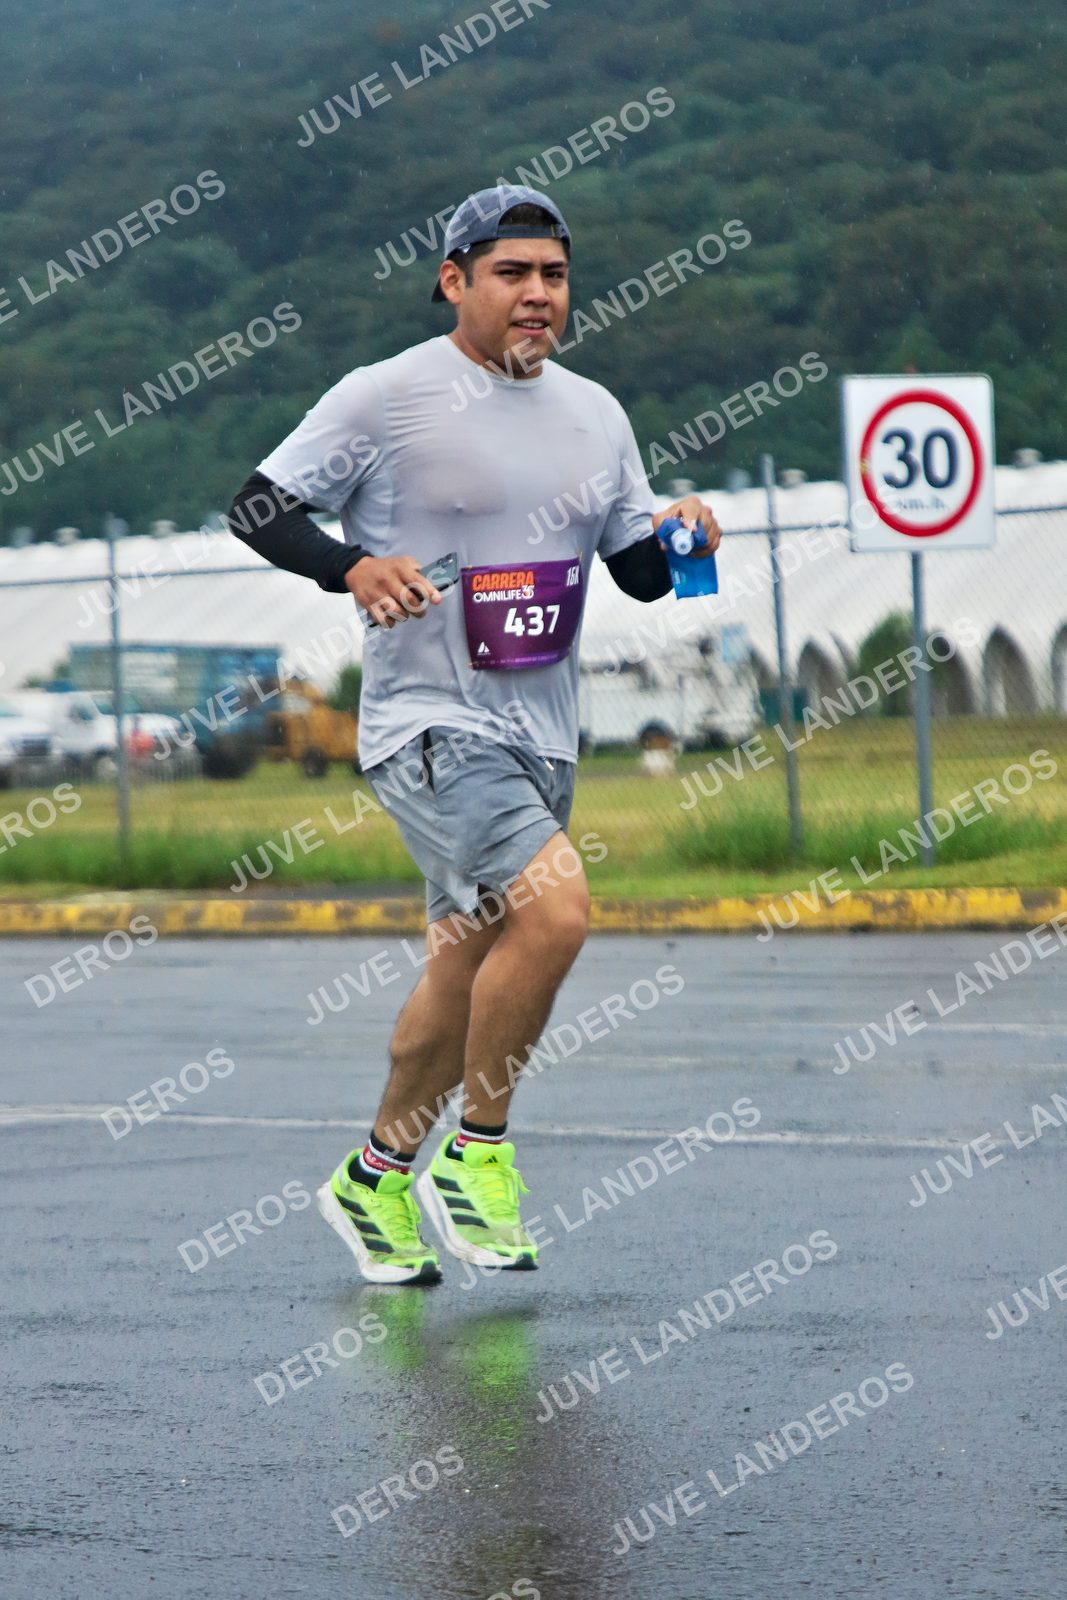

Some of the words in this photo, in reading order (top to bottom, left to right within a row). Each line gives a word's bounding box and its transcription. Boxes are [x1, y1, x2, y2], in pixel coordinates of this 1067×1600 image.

[881, 426, 960, 489] 30
[472, 569, 535, 592] CARRERA
[504, 604, 560, 638] 437
